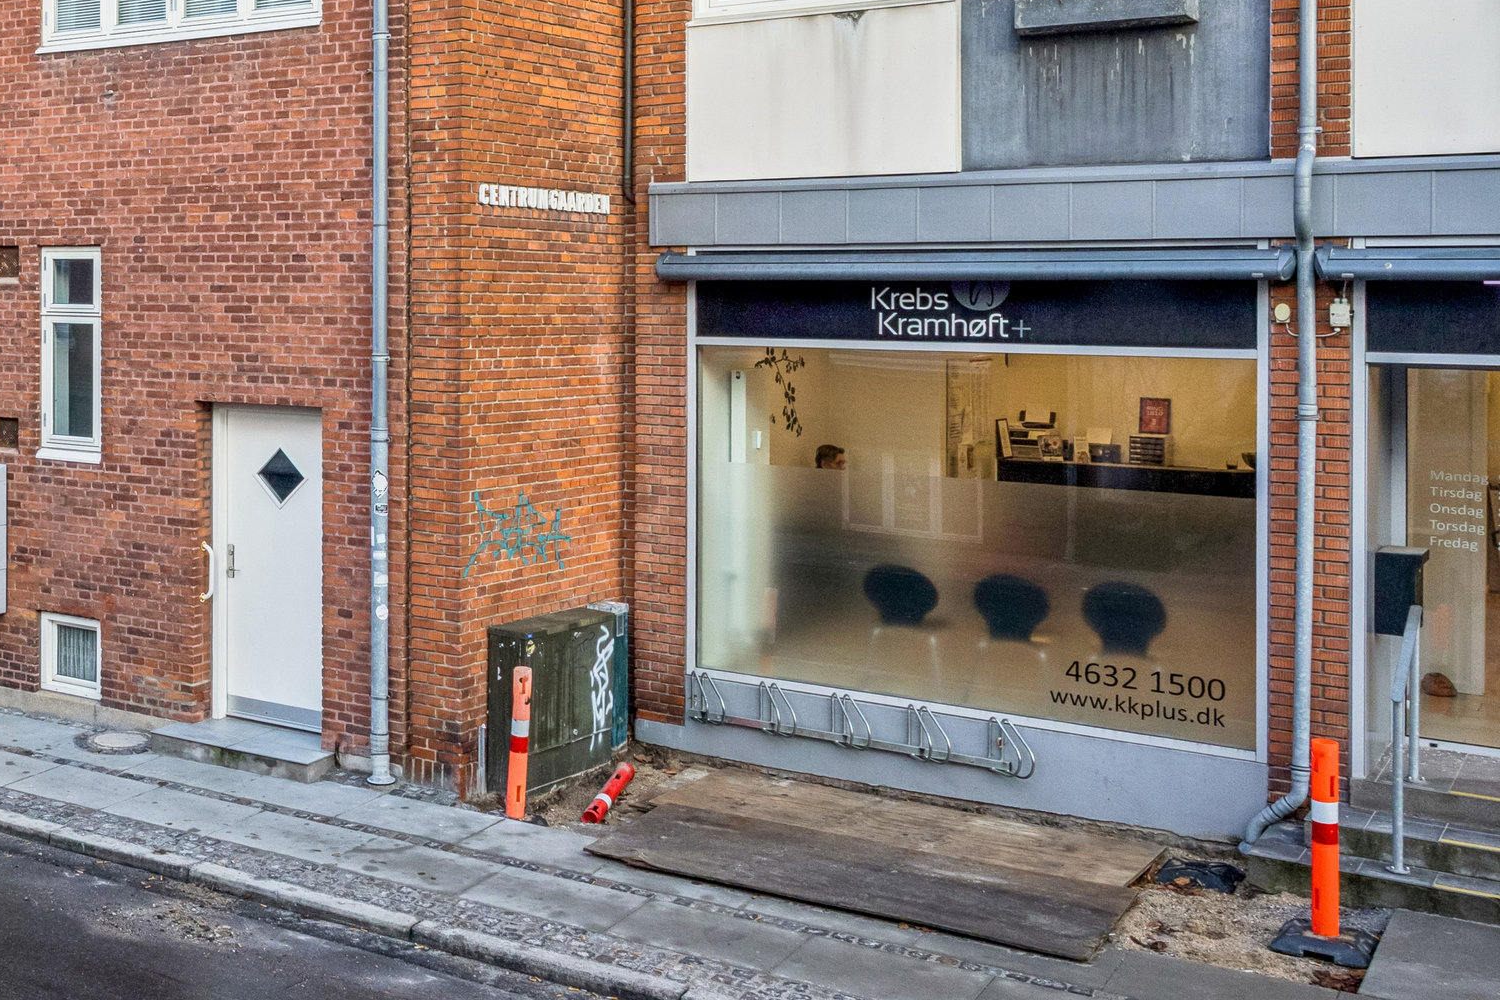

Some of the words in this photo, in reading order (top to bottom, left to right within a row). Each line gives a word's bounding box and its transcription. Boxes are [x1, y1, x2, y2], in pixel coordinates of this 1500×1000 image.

[871, 287, 949, 310] Krebs
[1430, 470, 1489, 486] Mandag
[1430, 487, 1483, 502] Tirsdag
[1430, 503, 1484, 519] Onsdag
[1429, 520, 1485, 536] Torsdag
[1430, 536, 1478, 552] Fredag
[1065, 661, 1138, 690] 4632
[1150, 671, 1226, 701] 1500
[1050, 690, 1226, 728] www.kkplus.dk
